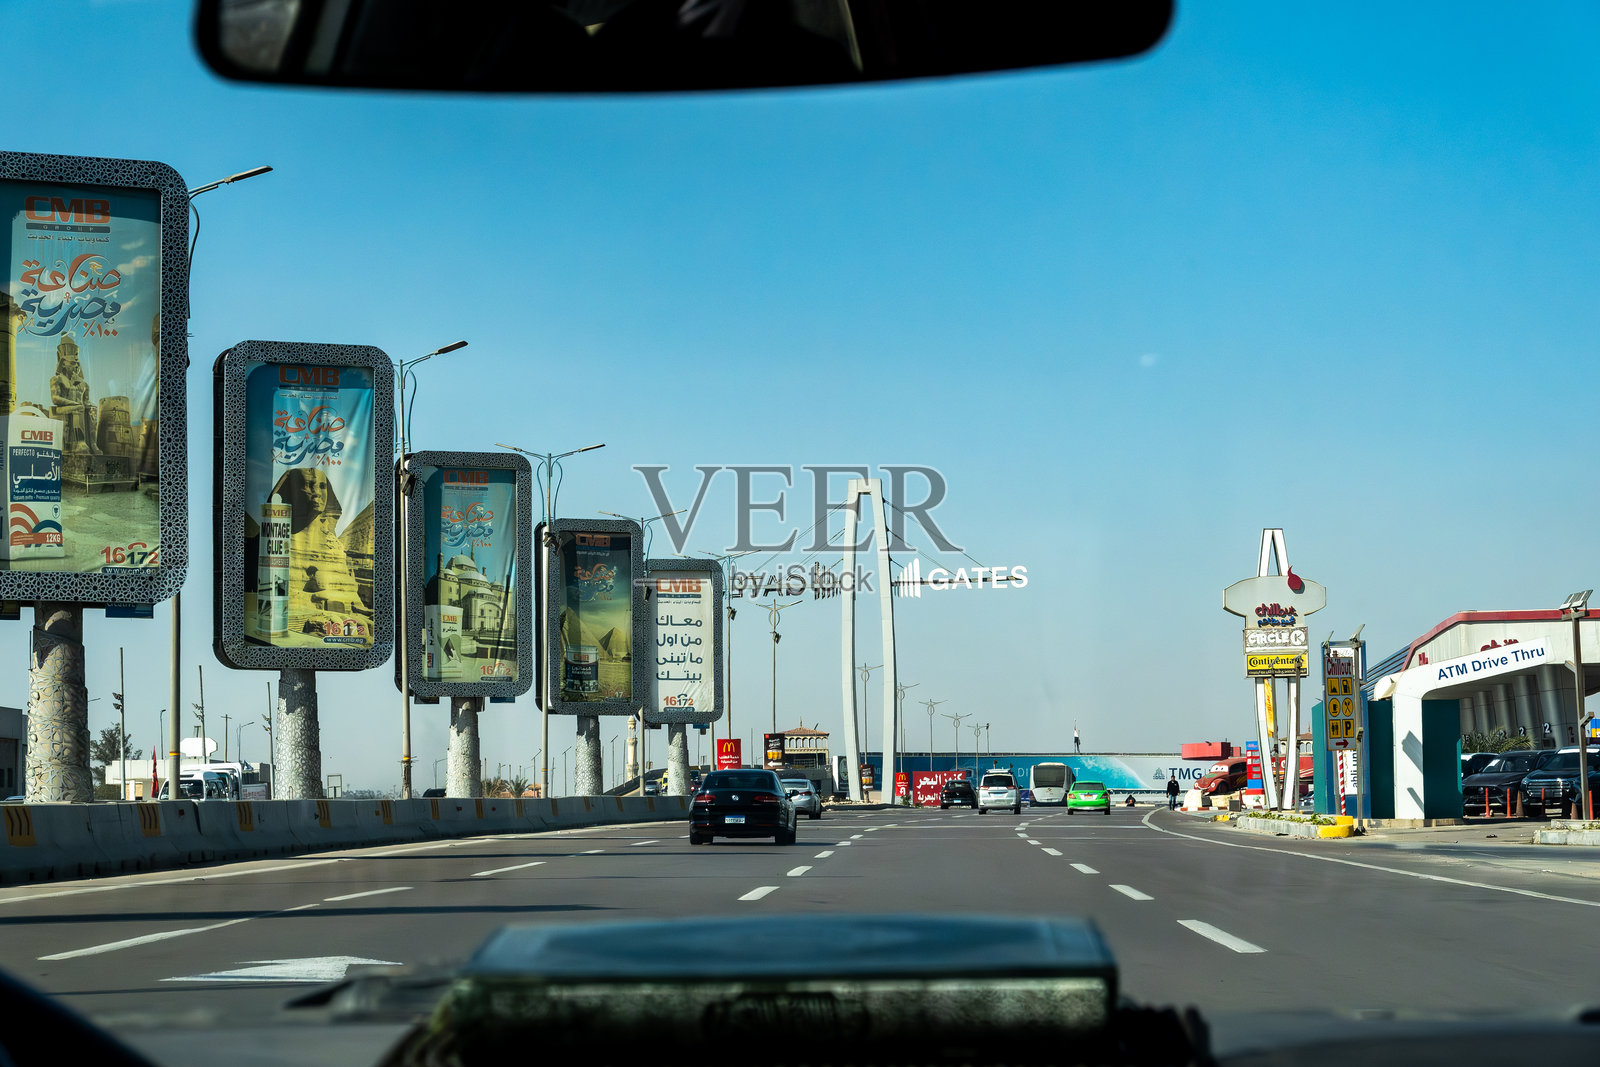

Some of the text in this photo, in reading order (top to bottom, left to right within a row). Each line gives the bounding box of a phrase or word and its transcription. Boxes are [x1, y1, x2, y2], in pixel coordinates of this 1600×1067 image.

[25, 195, 110, 224] CMB
[20, 253, 121, 293] صناعة
[19, 288, 121, 337] مصرية
[280, 365, 340, 387] CMB
[21, 430, 54, 441] CMB
[12, 448, 36, 457] PERFECTO
[12, 461, 61, 489] الأصلي
[444, 471, 489, 486] CMB
[261, 521, 290, 539] MONTAGE
[46, 533, 61, 543] 12KG
[575, 533, 611, 547] CMB
[266, 540, 283, 555] GLUE
[101, 546, 159, 565] 16172
[927, 565, 1029, 591] GATES
[656, 578, 702, 593] CMB
[1255, 603, 1298, 617] chillout
[656, 615, 703, 627] معاك
[322, 622, 365, 636] 16172
[656, 633, 703, 647] من اول
[1248, 632, 1290, 645] CIRCLE
[656, 652, 703, 665] ما تبنى
[1249, 656, 1300, 667] Continenta
[1438, 647, 1545, 680] ATM Drive Thru
[1326, 658, 1352, 676] Chillout
[656, 670, 703, 684] بيتك
[663, 695, 694, 706] 16172
[1168, 767, 1203, 781] TMG
[916, 773, 942, 790] البحر
